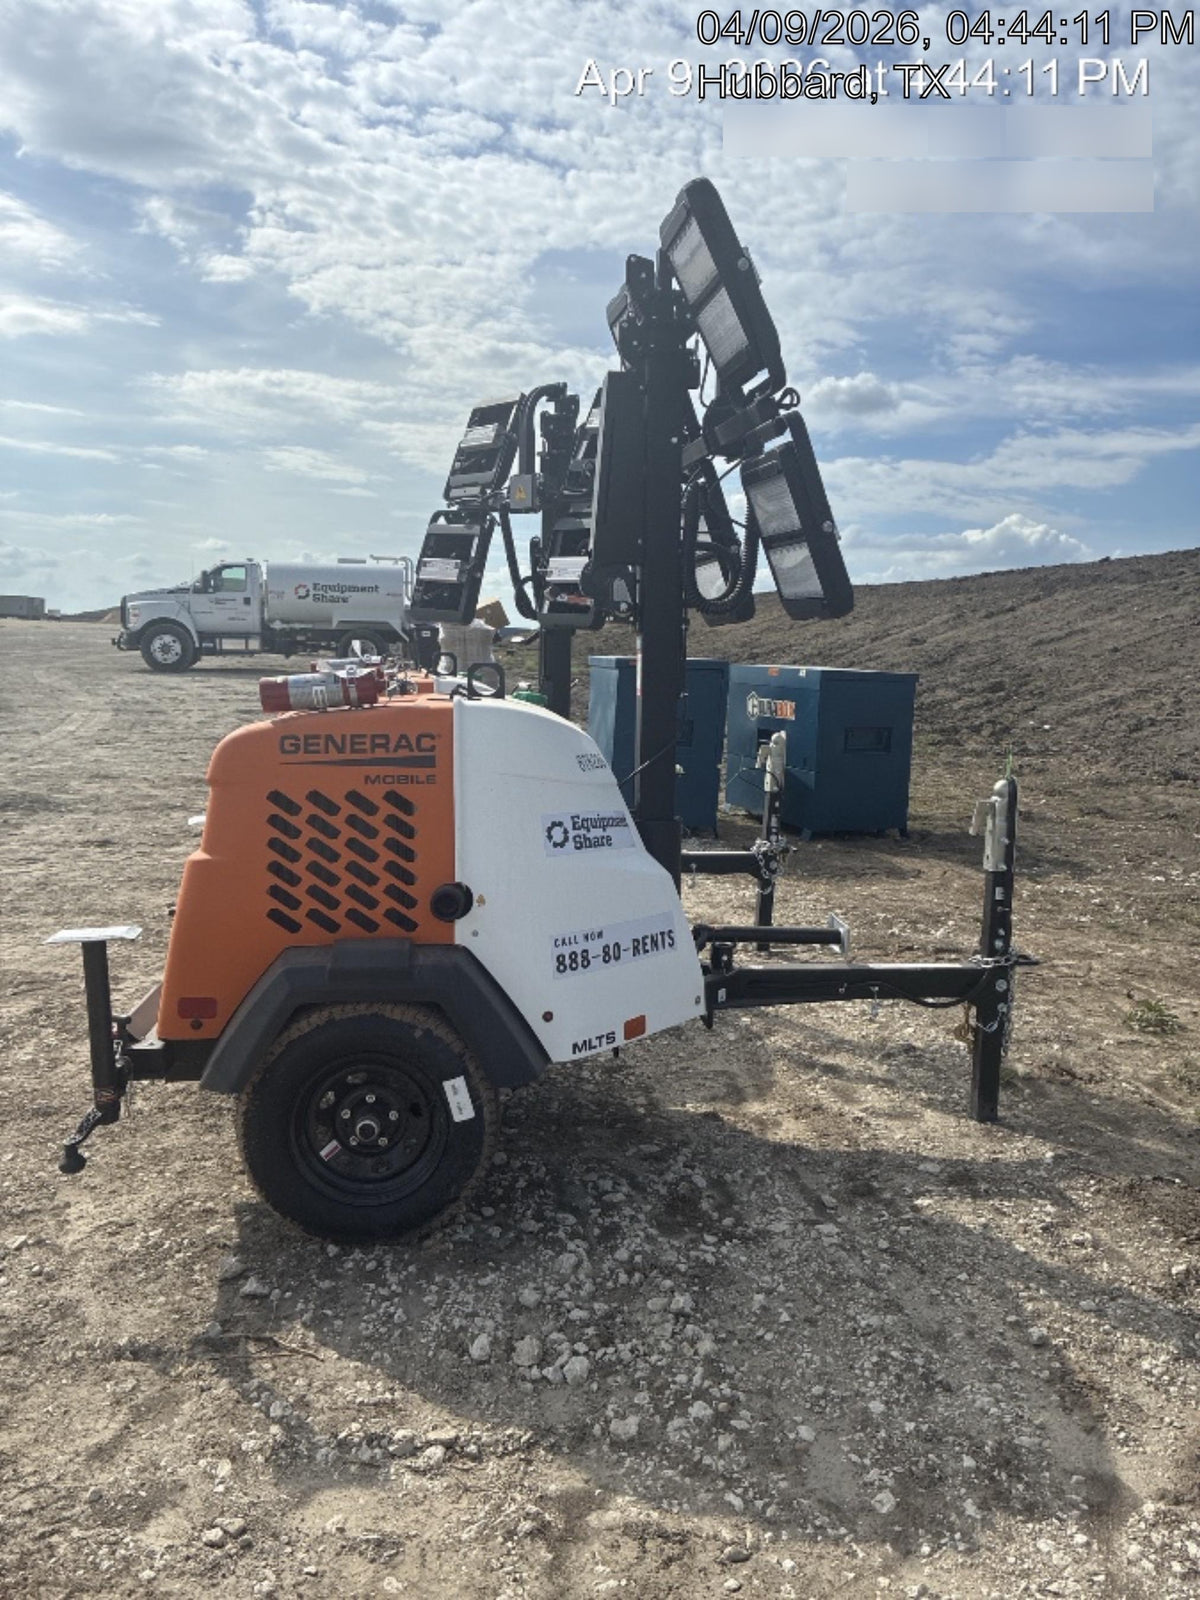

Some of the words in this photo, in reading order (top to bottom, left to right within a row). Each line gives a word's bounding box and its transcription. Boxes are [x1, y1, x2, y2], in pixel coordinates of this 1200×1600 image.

[312, 582, 380, 596] Equipment
[312, 593, 350, 604] Share
[279, 733, 436, 755] GENERAC
[364, 774, 436, 785] MOBILE
[572, 834, 613, 850] Share
[554, 935, 579, 948] CALL
[583, 930, 604, 942] NOW
[556, 929, 675, 974] 888-80-RENTS
